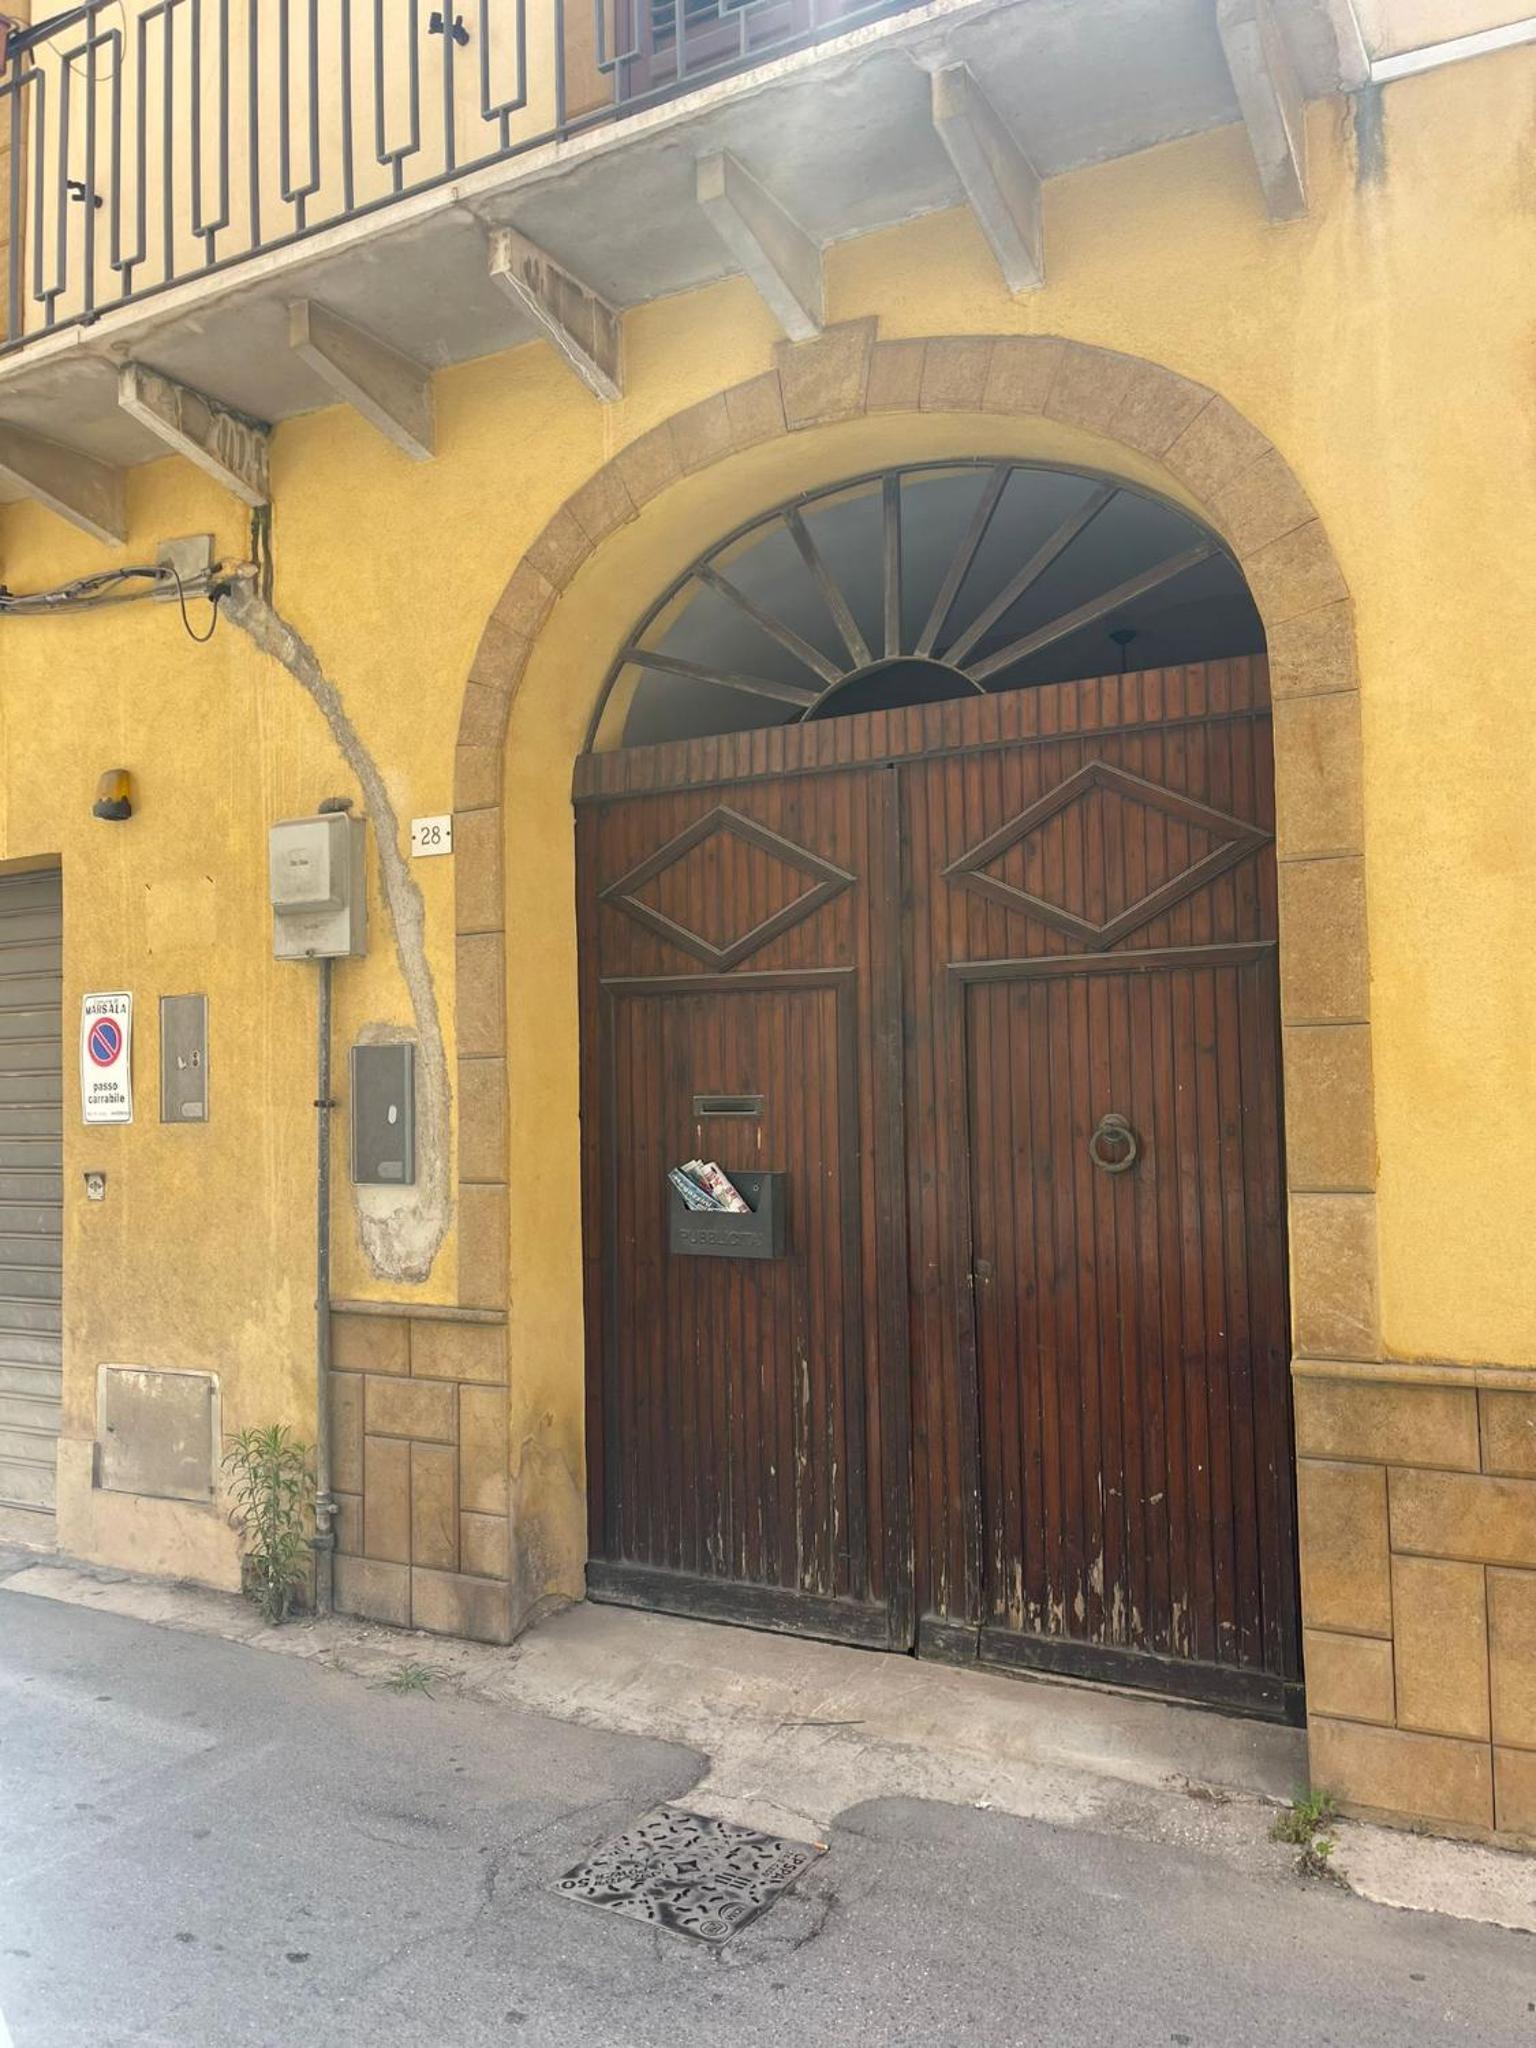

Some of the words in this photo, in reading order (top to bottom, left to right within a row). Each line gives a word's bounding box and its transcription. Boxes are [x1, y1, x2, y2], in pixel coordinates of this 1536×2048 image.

[420, 825, 442, 846] 28
[85, 1003, 127, 1015] MARSALA
[93, 1082, 118, 1094] passo
[88, 1092, 125, 1104] carrabile
